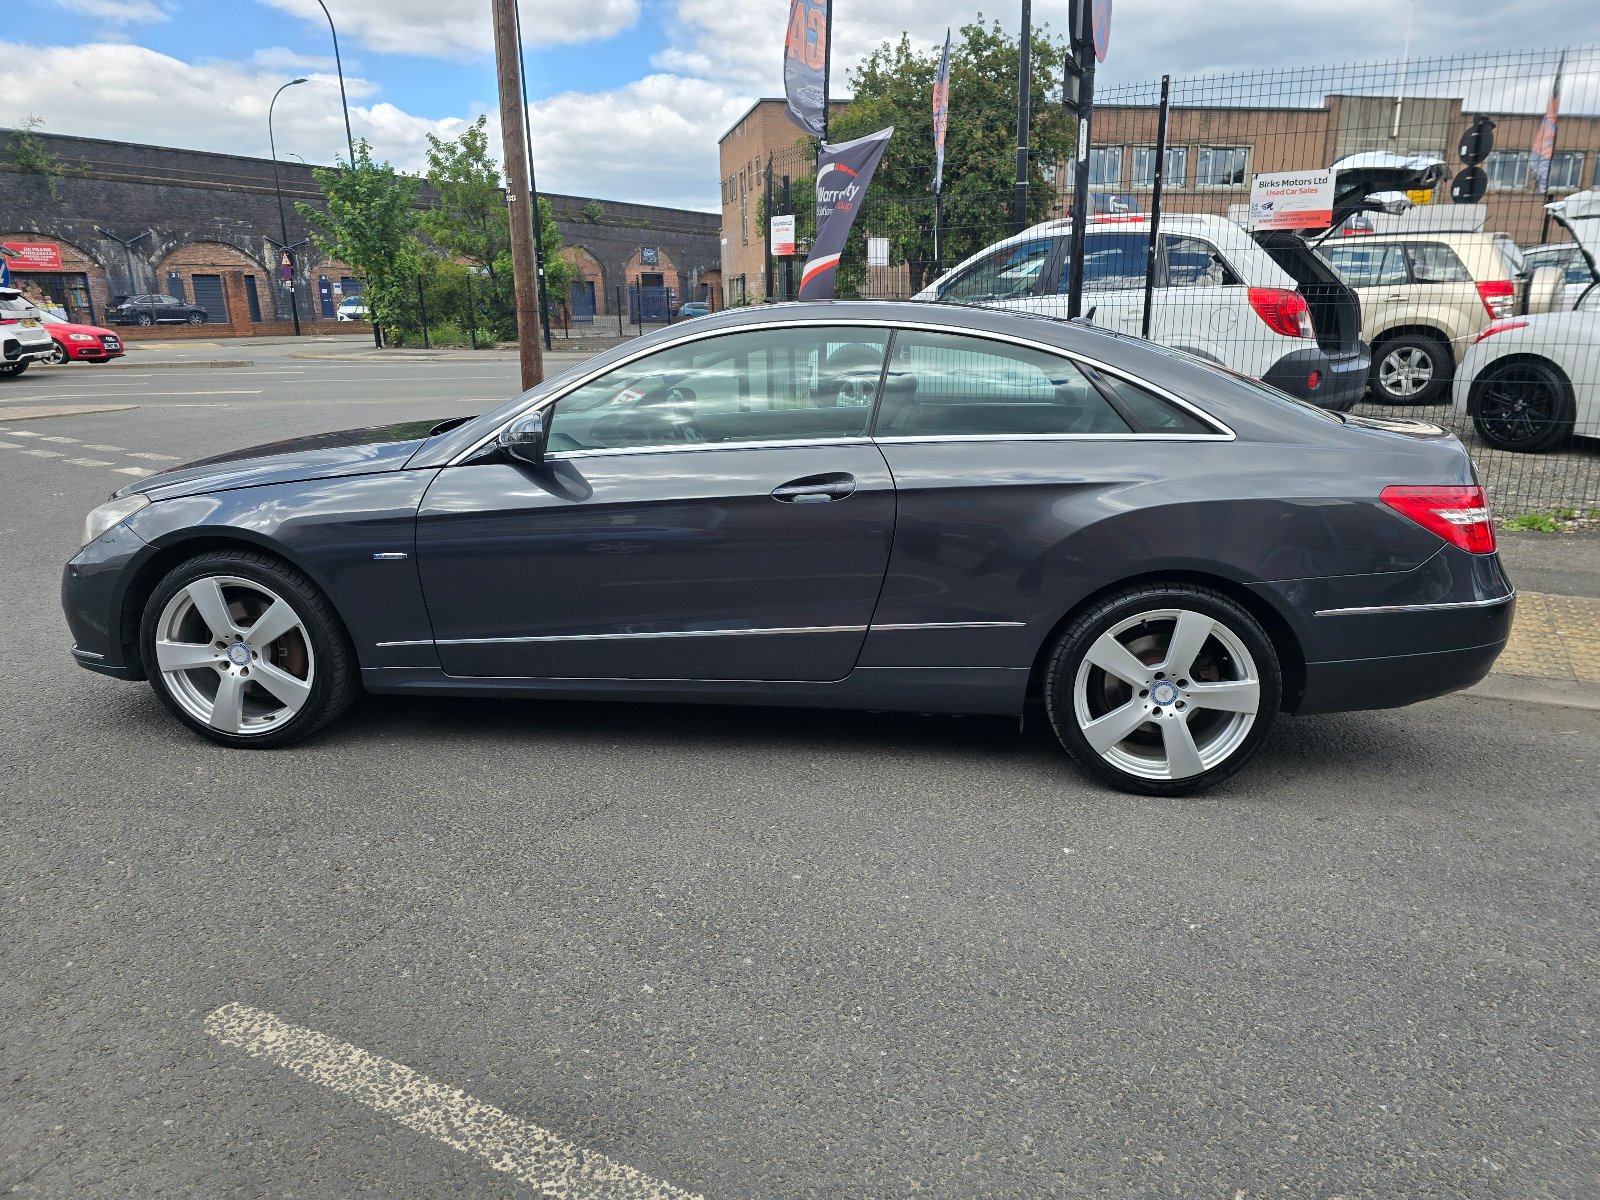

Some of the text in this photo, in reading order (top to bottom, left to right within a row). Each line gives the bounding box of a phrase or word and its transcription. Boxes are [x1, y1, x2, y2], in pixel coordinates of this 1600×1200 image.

[1259, 177, 1328, 189] Birks Motors Ltd
[817, 182, 860, 202] Warrty
